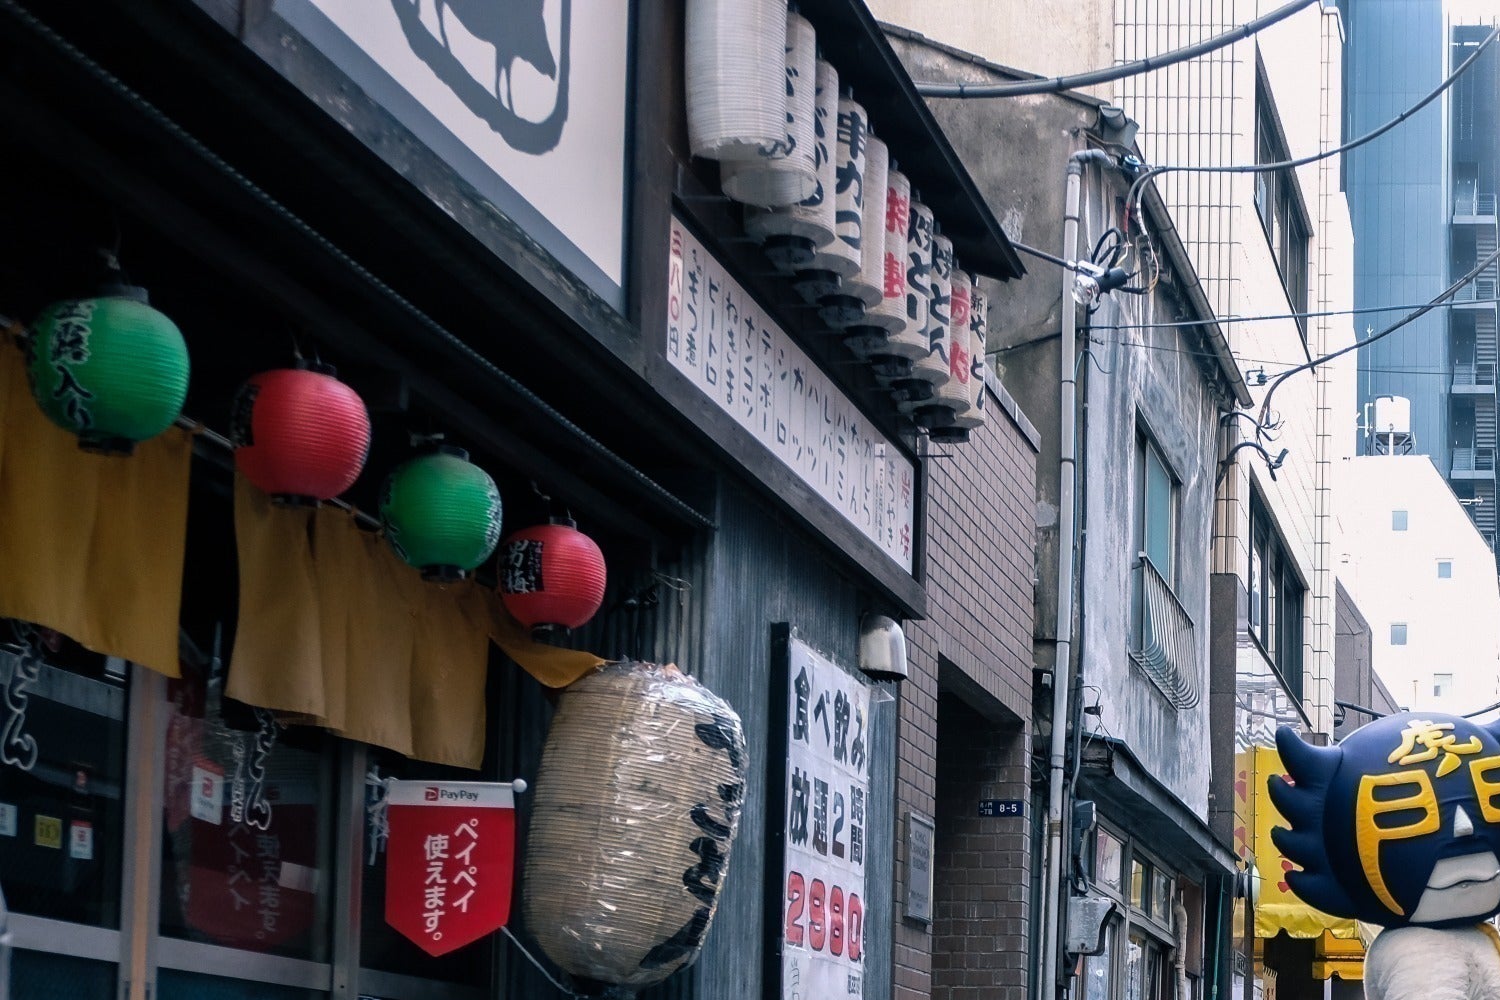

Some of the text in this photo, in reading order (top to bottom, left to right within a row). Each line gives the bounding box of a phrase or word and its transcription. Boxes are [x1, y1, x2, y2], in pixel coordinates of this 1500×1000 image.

[743, 316, 755, 417] ナンコツ
[793, 666, 866, 774] 食べ飲み
[440, 789, 479, 802] PayPay
[790, 768, 864, 866] 放題2時間
[999, 804, 1017, 813] 8-5
[423, 834, 449, 941] 使えます。
[453, 818, 478, 912] ペイペイ
[785, 870, 863, 961] 2980
